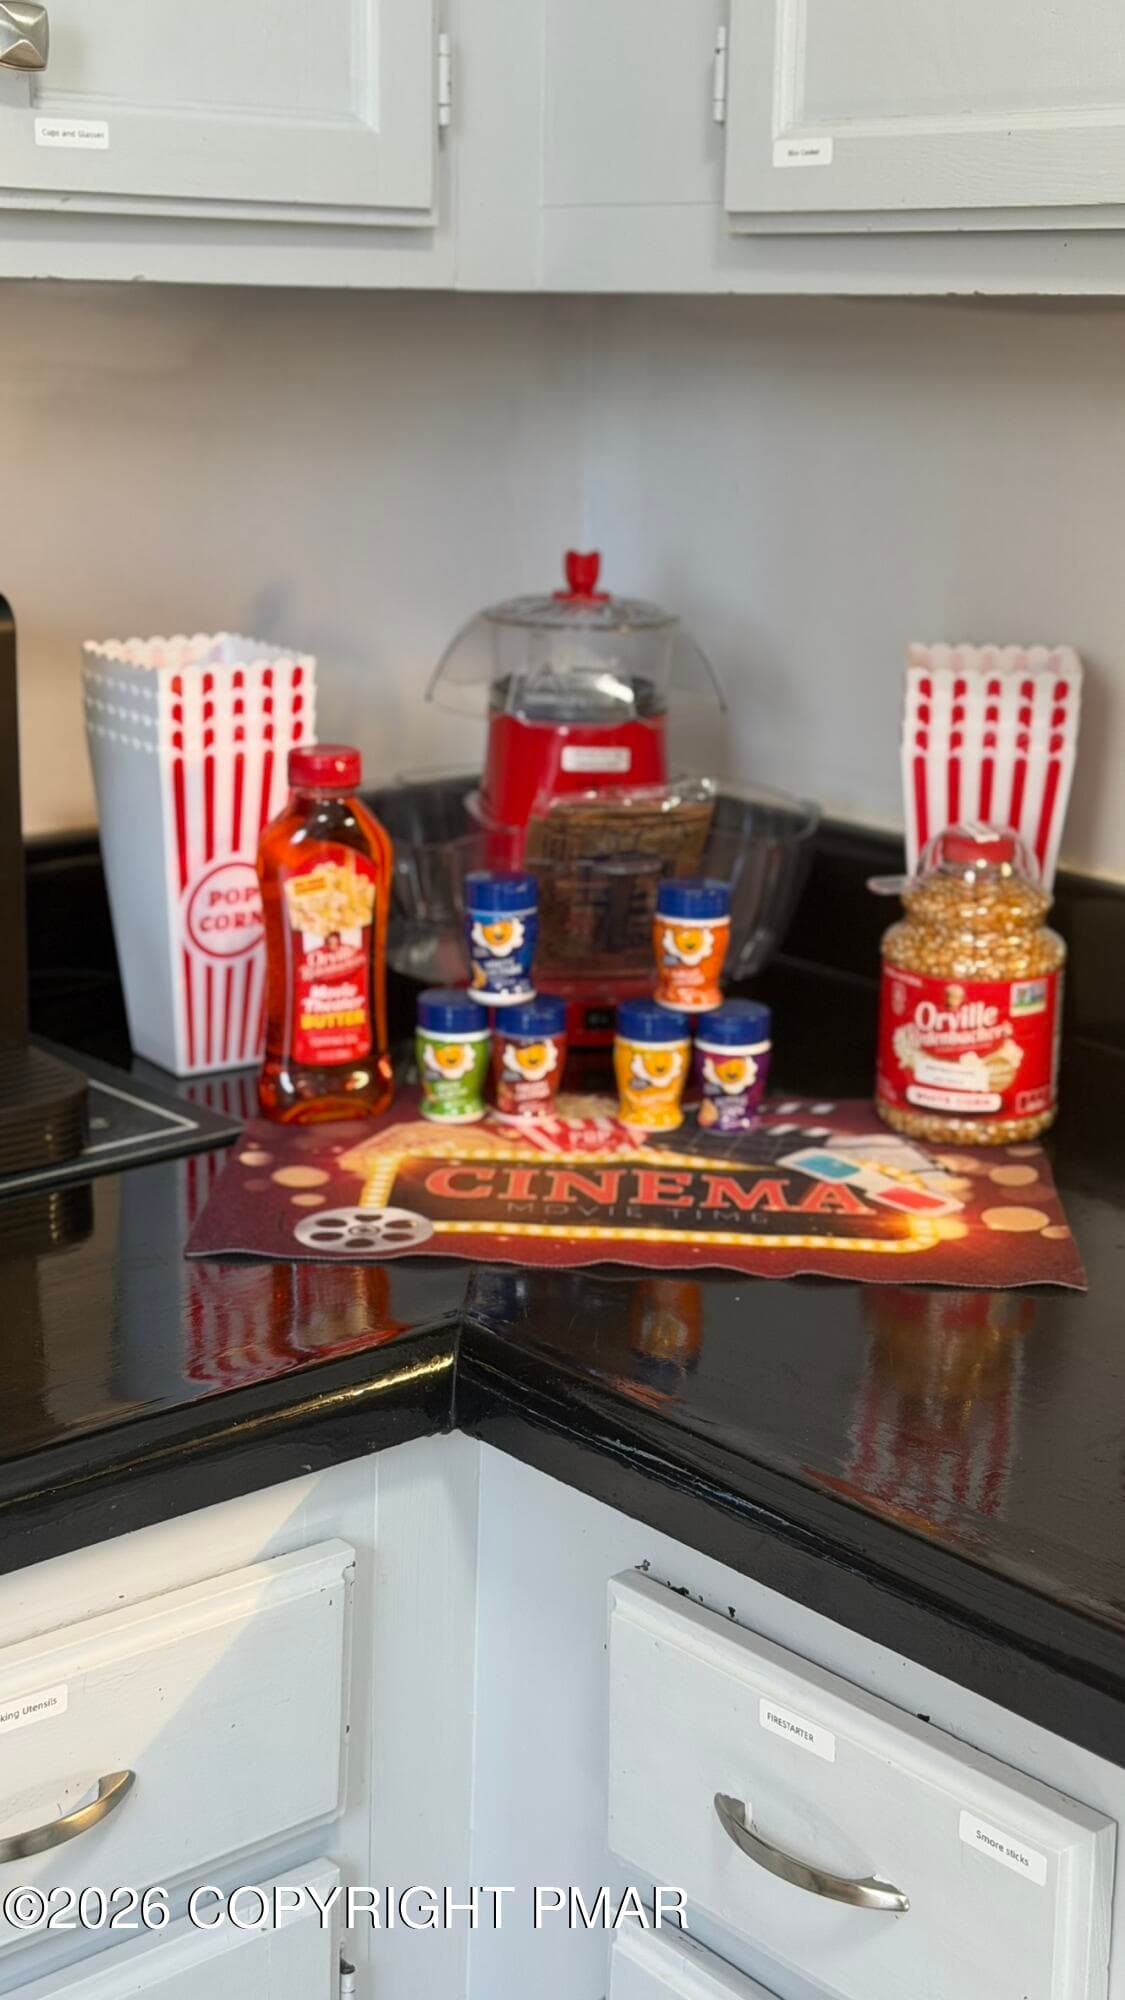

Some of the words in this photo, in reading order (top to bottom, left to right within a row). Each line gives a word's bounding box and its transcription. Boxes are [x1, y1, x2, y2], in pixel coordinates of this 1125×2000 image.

[209, 888, 259, 907] POP
[300, 1008, 366, 1031] BUTTER
[914, 1001, 999, 1033] Orville
[424, 1166, 877, 1216] CINEMA
[506, 1202, 643, 1218] MOVIE
[666, 1208, 769, 1225] TIME
[22, 1697, 58, 1715] Utensils
[767, 1712, 814, 1743] FIRESTARTER
[975, 1830, 1005, 1853] Smore
[1005, 1848, 1030, 1867] sticks
